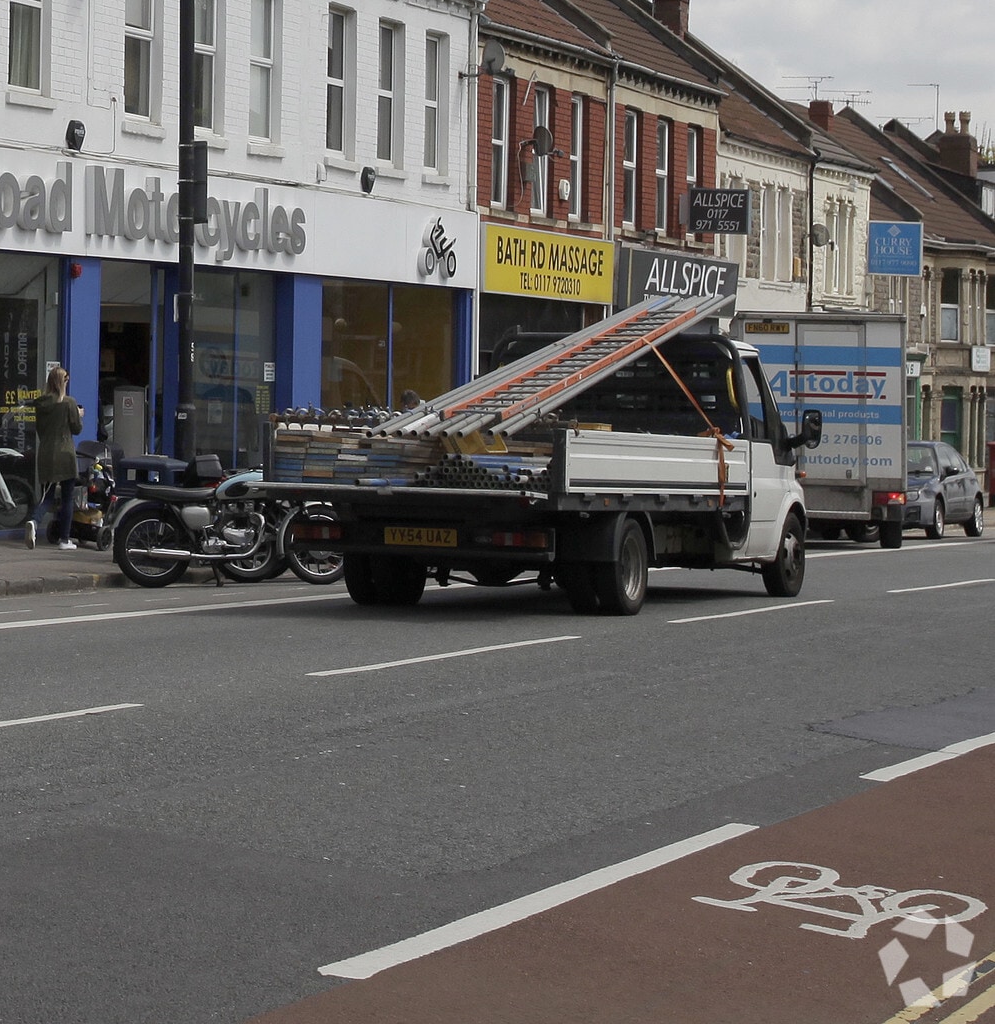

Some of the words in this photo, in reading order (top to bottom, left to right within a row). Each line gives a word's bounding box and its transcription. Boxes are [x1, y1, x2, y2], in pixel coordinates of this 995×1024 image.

[693, 193, 744, 208] ALLSPICE
[85, 166, 306, 261] Motocycles
[706, 209, 728, 219] 0117
[696, 220, 712, 230] 971
[717, 221, 740, 231] 5551
[875, 237, 912, 246] CURRY
[497, 236, 526, 267] BATH
[530, 241, 545, 269] RD
[548, 243, 604, 276] MASSAGE
[875, 246, 912, 255] HOUSE
[520, 272, 532, 290] TEL:
[534, 274, 550, 292] 0117
[553, 276, 580, 295] 9720310
[645, 258, 727, 298] ALLSPICE
[18, 332, 27, 376] JOFAMA
[770, 370, 886, 399] Autoday
[838, 411, 879, 419] products
[390, 529, 422, 542] YY54
[426, 530, 451, 543] UAZ
